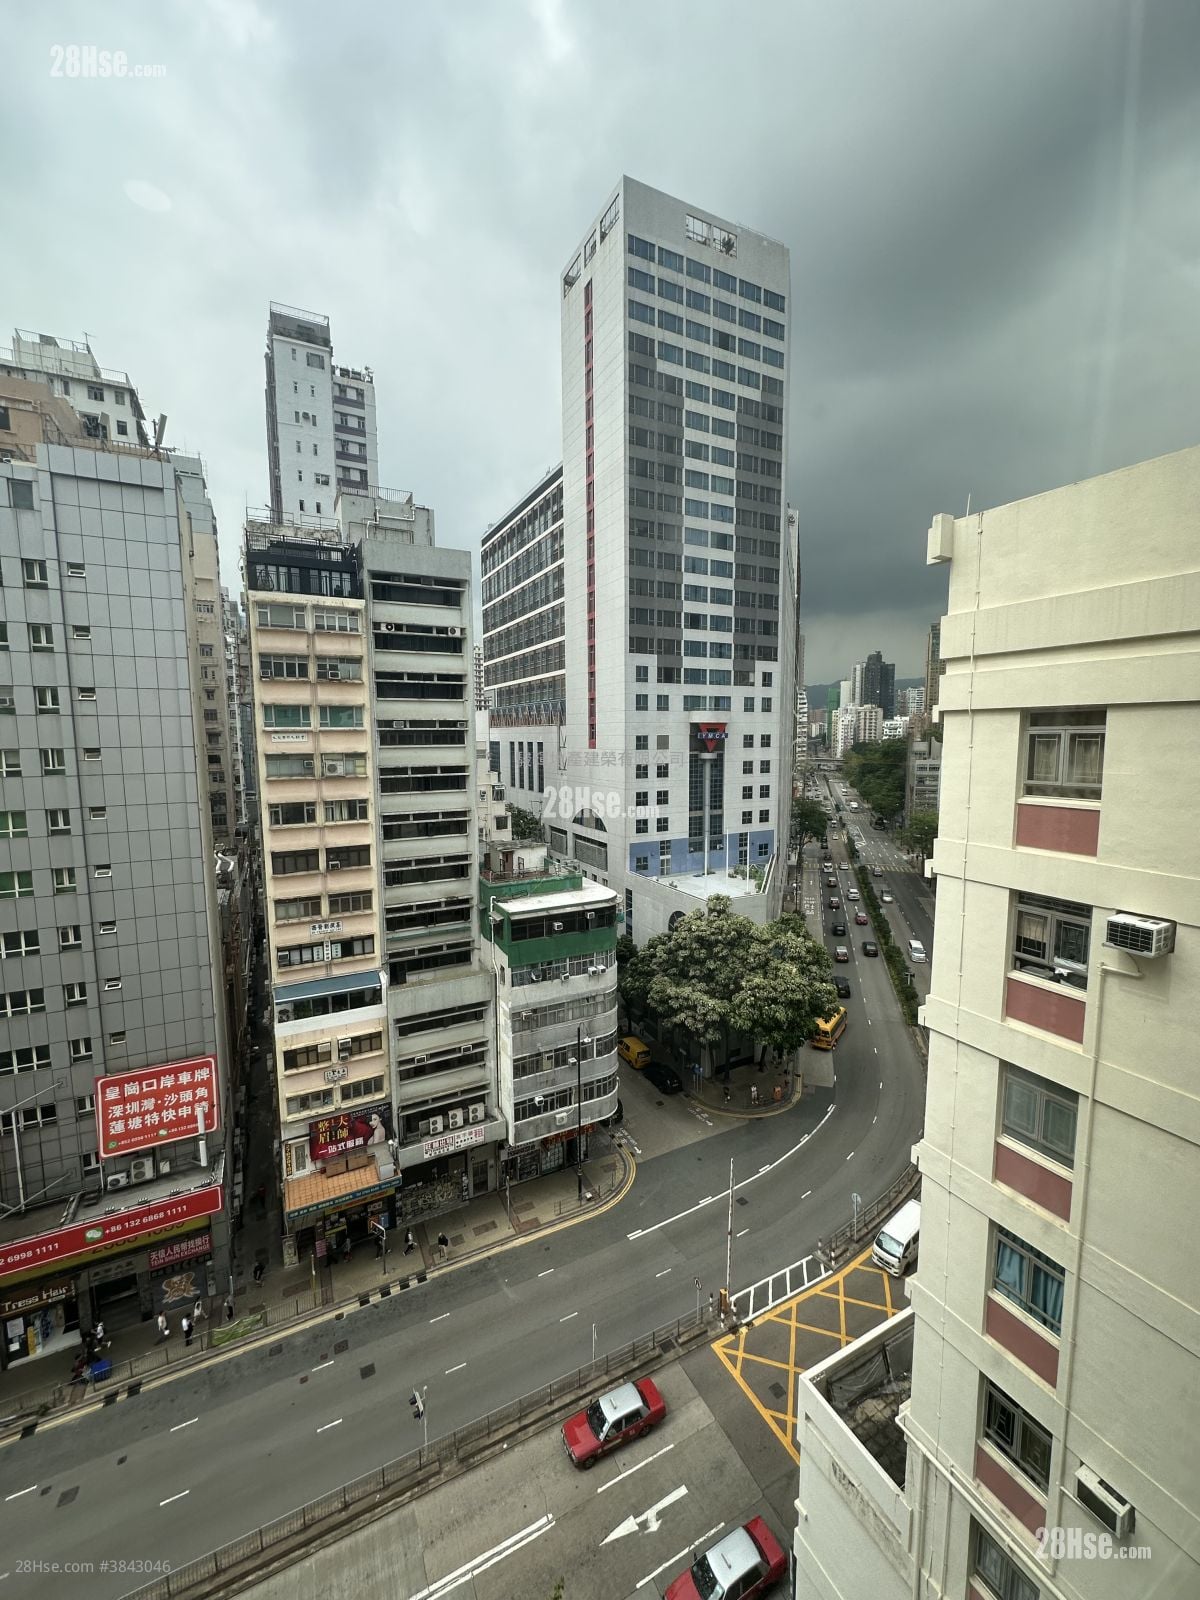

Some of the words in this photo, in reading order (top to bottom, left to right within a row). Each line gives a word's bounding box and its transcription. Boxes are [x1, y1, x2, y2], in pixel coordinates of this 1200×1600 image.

[105, 1067, 210, 1101] 皇崗口岸車牌
[105, 1224, 122, 1235] +86
[124, 1218, 141, 1229] 132
[142, 1212, 165, 1224] 6868
[166, 1205, 188, 1217] 1111
[7, 1250, 33, 1263] 6998
[35, 1242, 59, 1255] 1111
[1, 1296, 39, 1311] Tress
[42, 1286, 68, 1300] Hair
